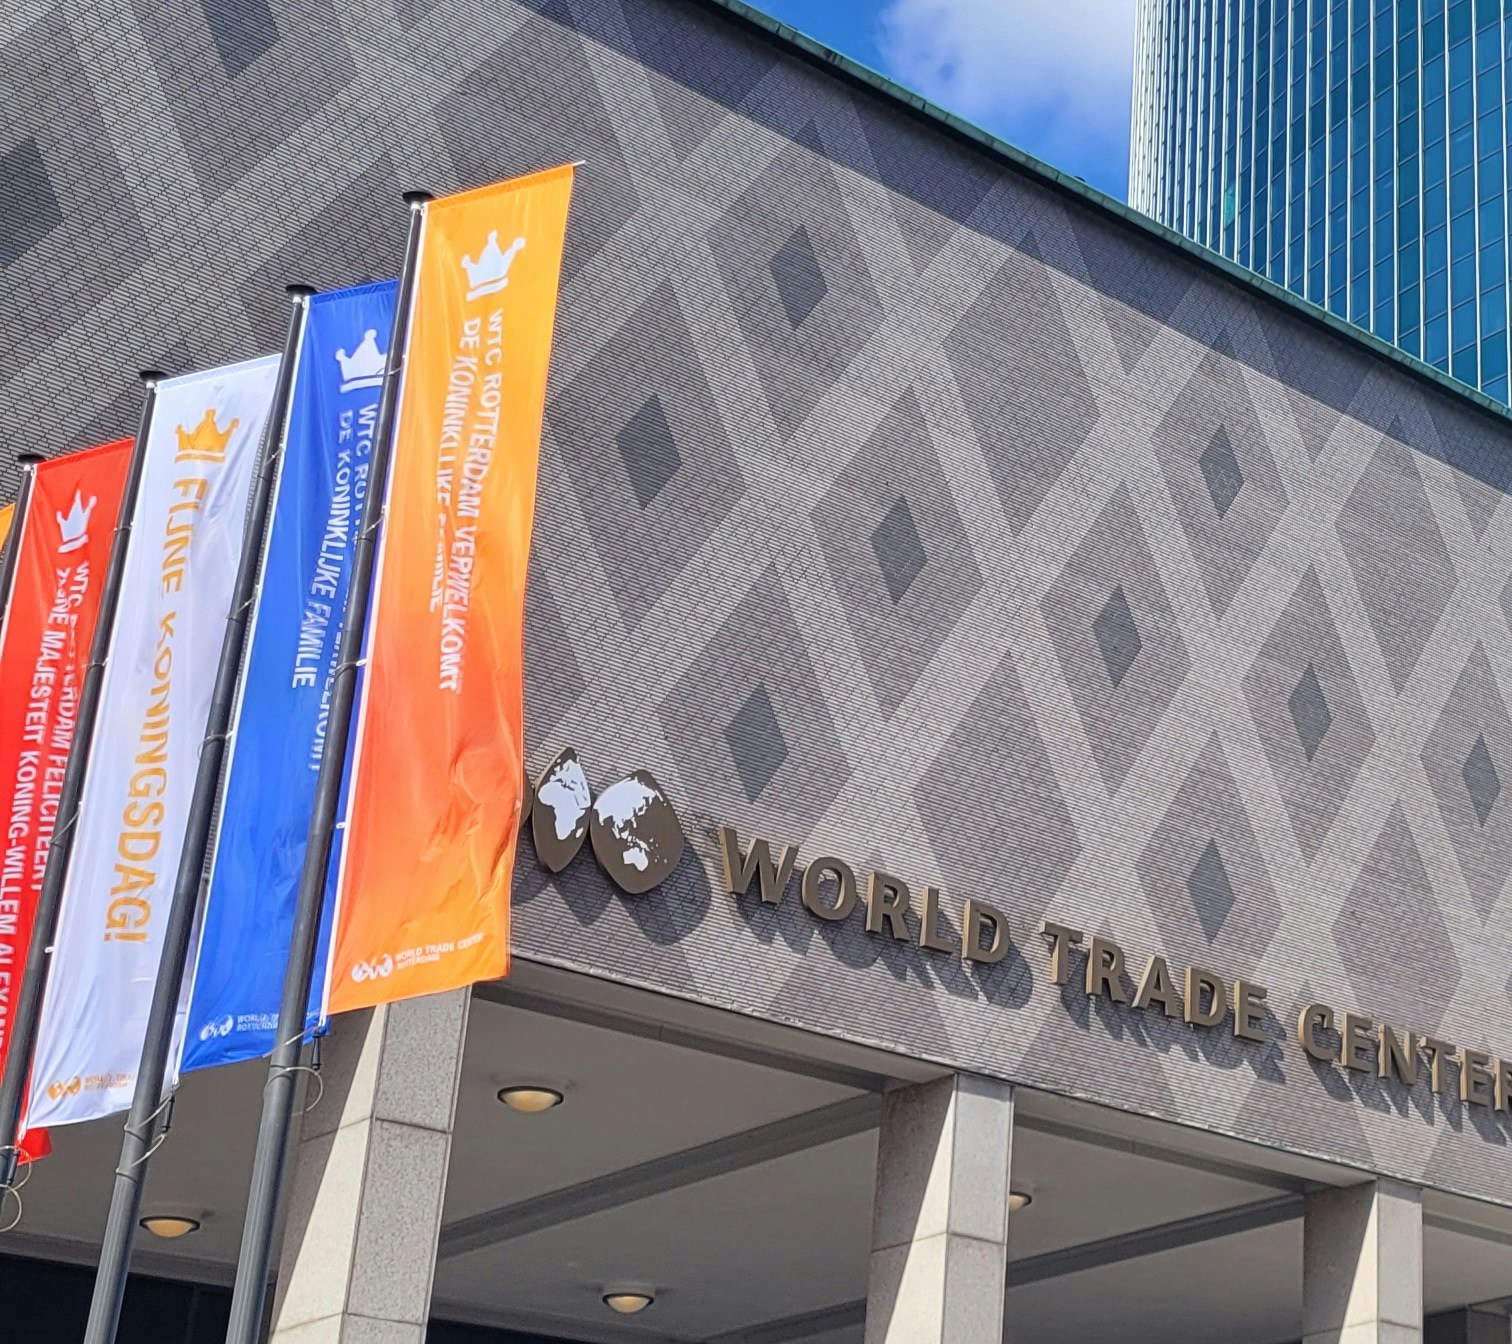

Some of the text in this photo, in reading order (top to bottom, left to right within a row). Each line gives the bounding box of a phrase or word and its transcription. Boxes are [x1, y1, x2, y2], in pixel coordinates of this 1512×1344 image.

[460, 316, 482, 349] DE
[355, 403, 379, 456] WTC
[439, 306, 503, 693] WTC ROTTERDAM VERWELKOMT
[68, 560, 90, 608] WTC
[291, 409, 354, 689] DE KONINKLIJKE FAMILIE
[23, 630, 67, 745] MAJESTEIT
[103, 478, 209, 943] FIJNE KONINGSDAG!
[718, 826, 1011, 964] WORLD
[1039, 921, 1269, 1042] TRADE
